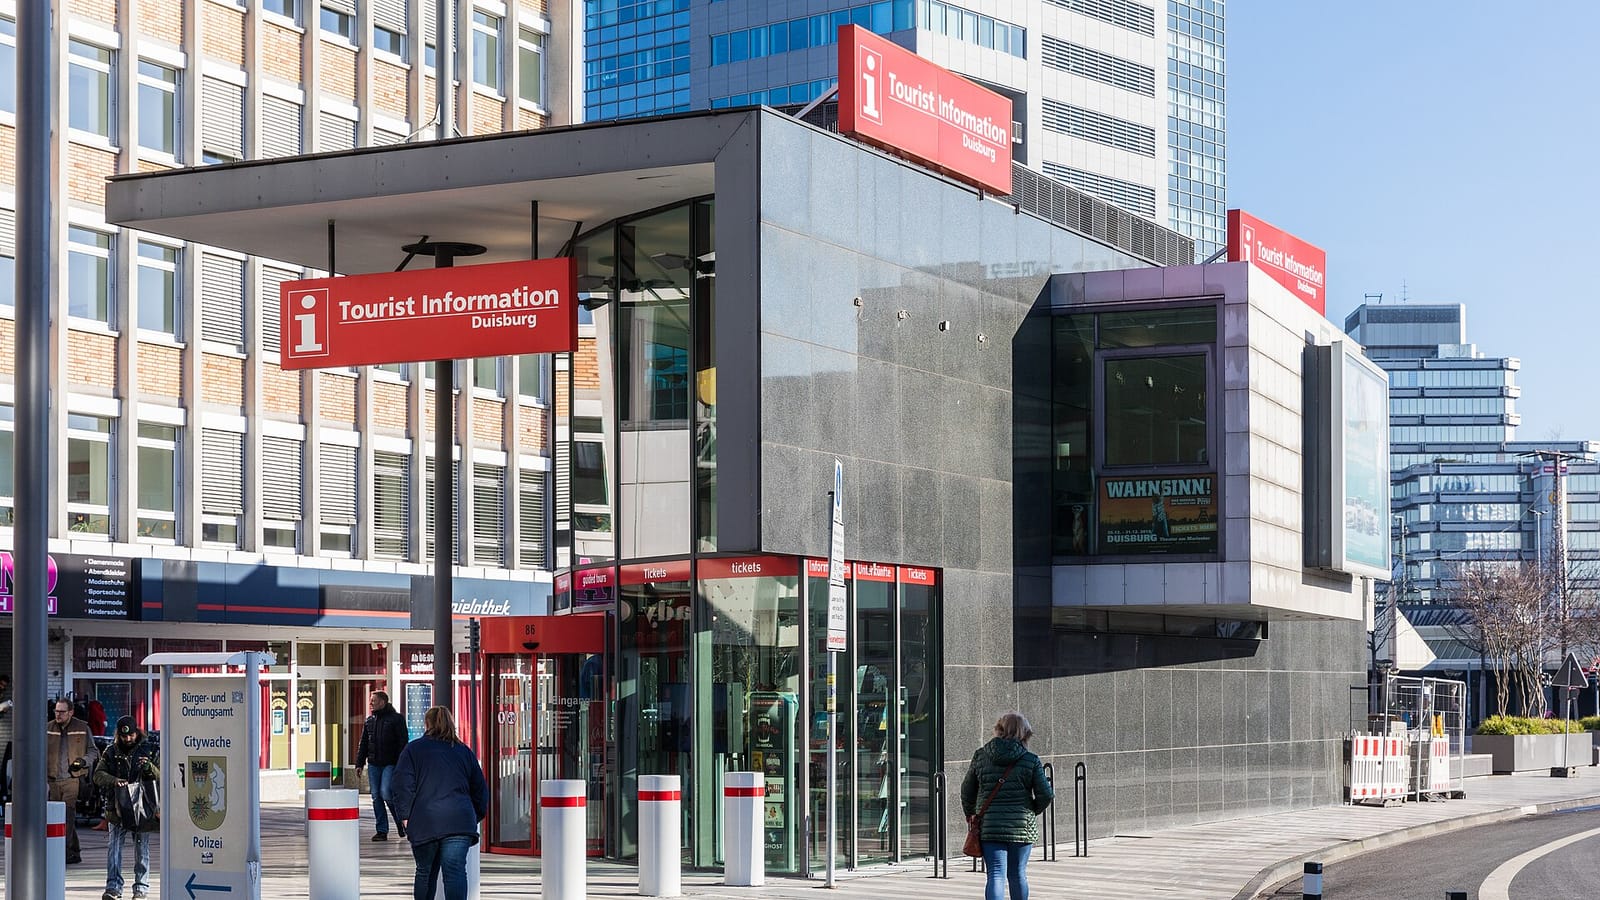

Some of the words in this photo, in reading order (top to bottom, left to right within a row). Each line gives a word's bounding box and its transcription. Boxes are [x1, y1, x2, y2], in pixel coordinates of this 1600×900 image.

[888, 72, 935, 112] Tourist
[938, 95, 1007, 145] Information
[962, 134, 996, 163] Duisburg
[1257, 241, 1283, 266] Tourist
[1284, 253, 1323, 284] Information
[1297, 280, 1316, 299] Duisburg
[339, 296, 415, 320] Tourist
[422, 286, 559, 315] Information
[471, 314, 537, 329] Duisburg
[1106, 479, 1211, 498] WAHNSINN!
[1107, 534, 1158, 543] DUISBURG
[88, 568, 126, 576] Abendkleider
[643, 568, 667, 579] Tickets
[731, 562, 761, 574] tickets
[907, 568, 927, 580] Tickets
[88, 608, 127, 616] Kinderschuhe
[452, 598, 511, 615] pielothek
[525, 624, 535, 635] 86
[87, 648, 97, 657] Ab
[98, 648, 119, 658] 06:00
[120, 648, 132, 658] Uhr
[182, 692, 209, 705] Bürger-
[211, 692, 226, 703] und
[552, 696, 591, 708] Eingang
[182, 706, 234, 719] Ordnungsamt
[184, 736, 231, 750] Citywache
[193, 836, 223, 849] Polizei
